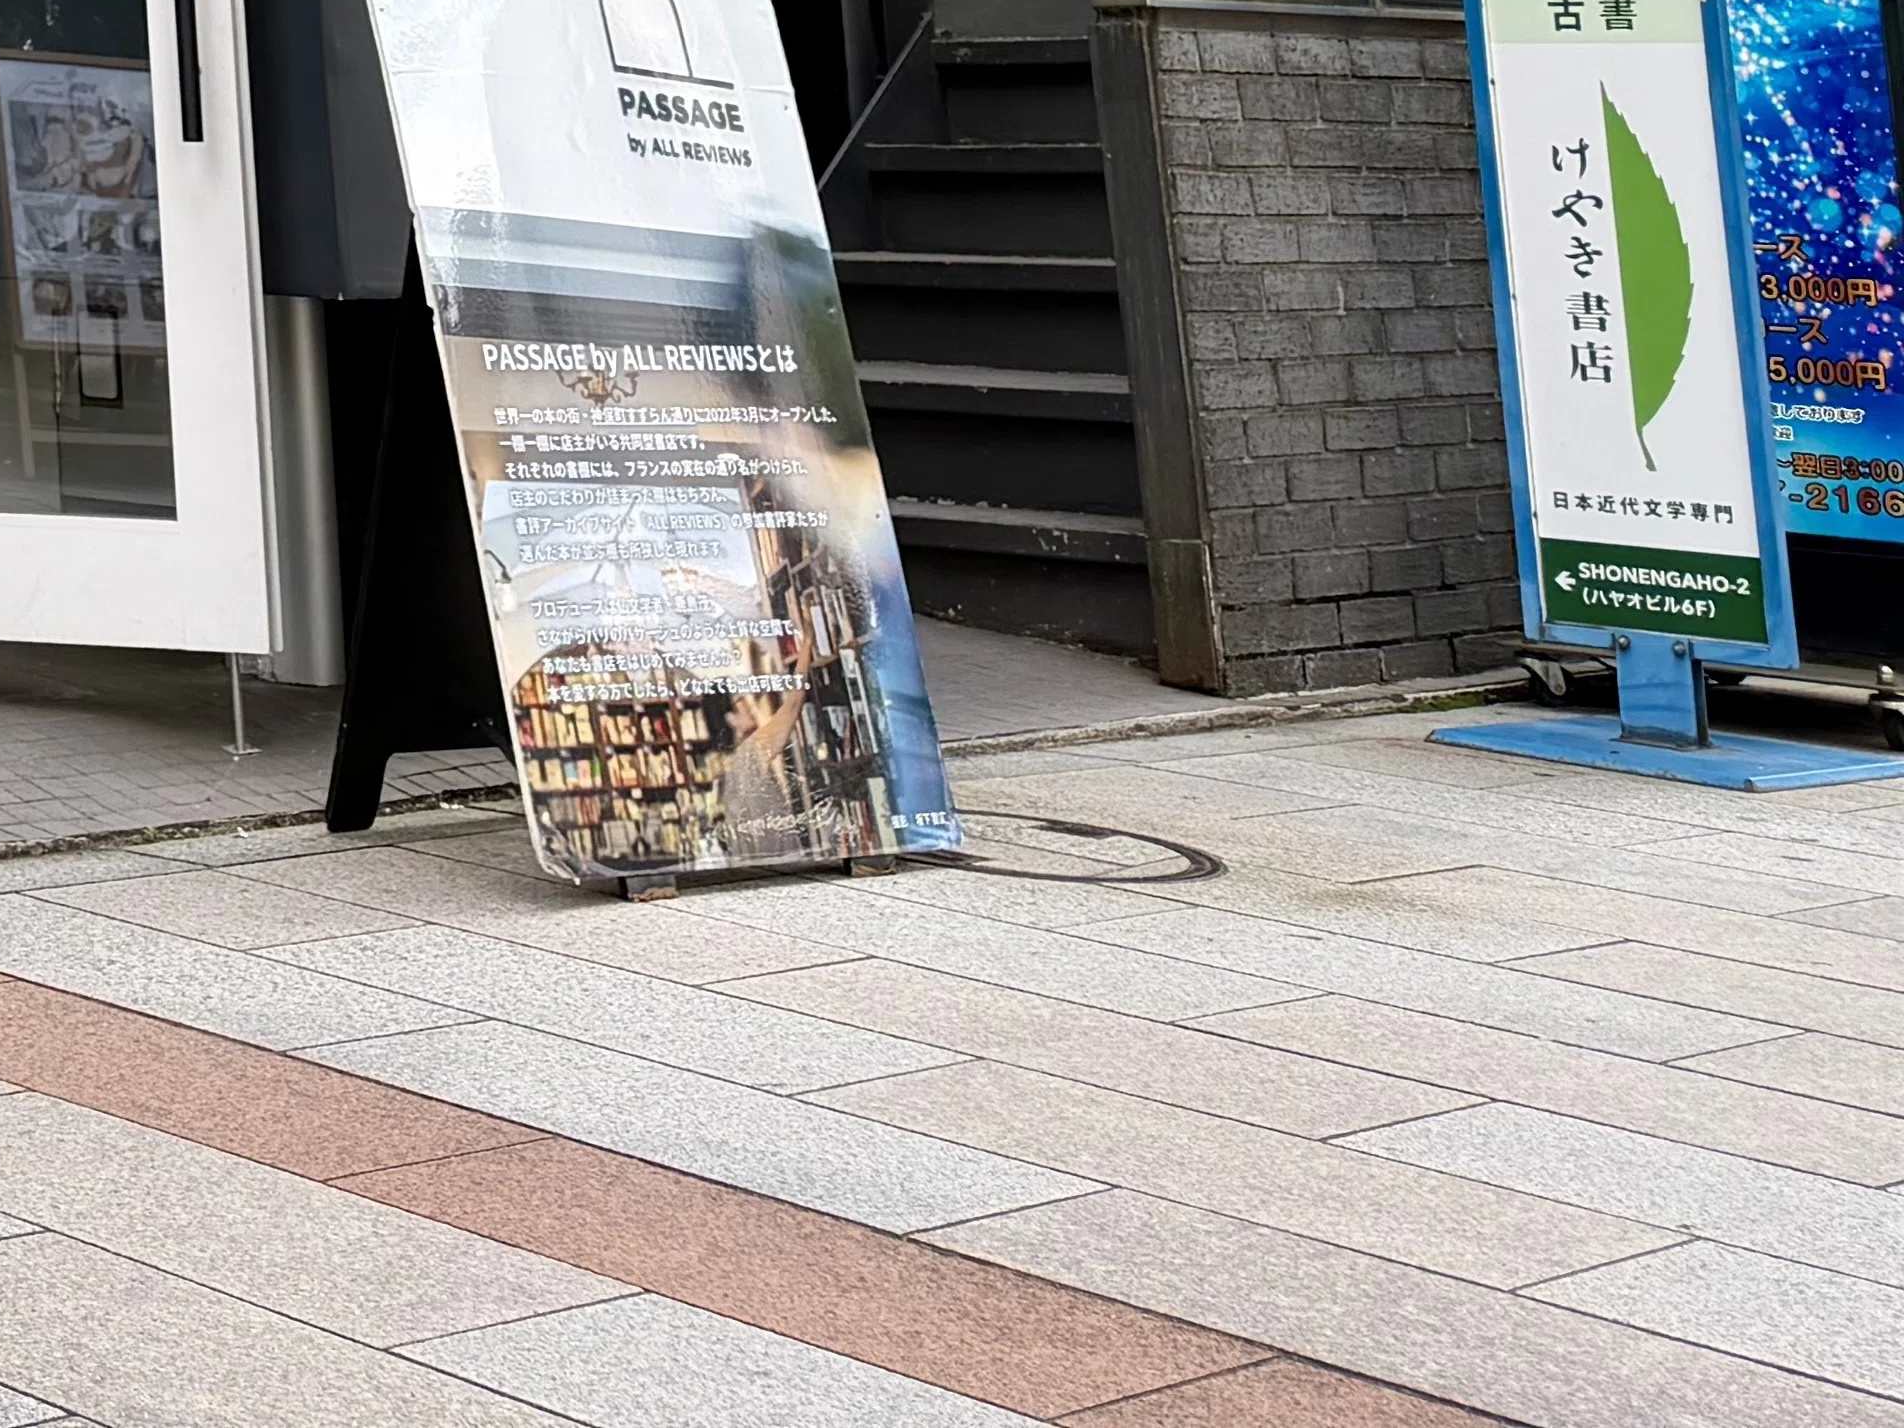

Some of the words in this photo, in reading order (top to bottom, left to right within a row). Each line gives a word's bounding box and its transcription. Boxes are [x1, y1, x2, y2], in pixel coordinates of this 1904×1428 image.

[617, 87, 745, 133] PASSAGE
[627, 132, 647, 158] by
[652, 137, 680, 158] ALL
[682, 141, 753, 168] REVIEWS
[1551, 138, 1614, 384] けやき書店
[1759, 273, 1880, 308] 3,000円
[1760, 316, 1829, 346] ース
[482, 343, 588, 372] PASSAGE
[589, 342, 618, 378] by
[622, 344, 664, 372] ALL
[664, 344, 799, 373] REVIEWSとは
[1767, 356, 1887, 392] 5,000円
[1552, 490, 1734, 524] 日本近代文学専門
[1577, 562, 1751, 596] SHONENGAHO-2
